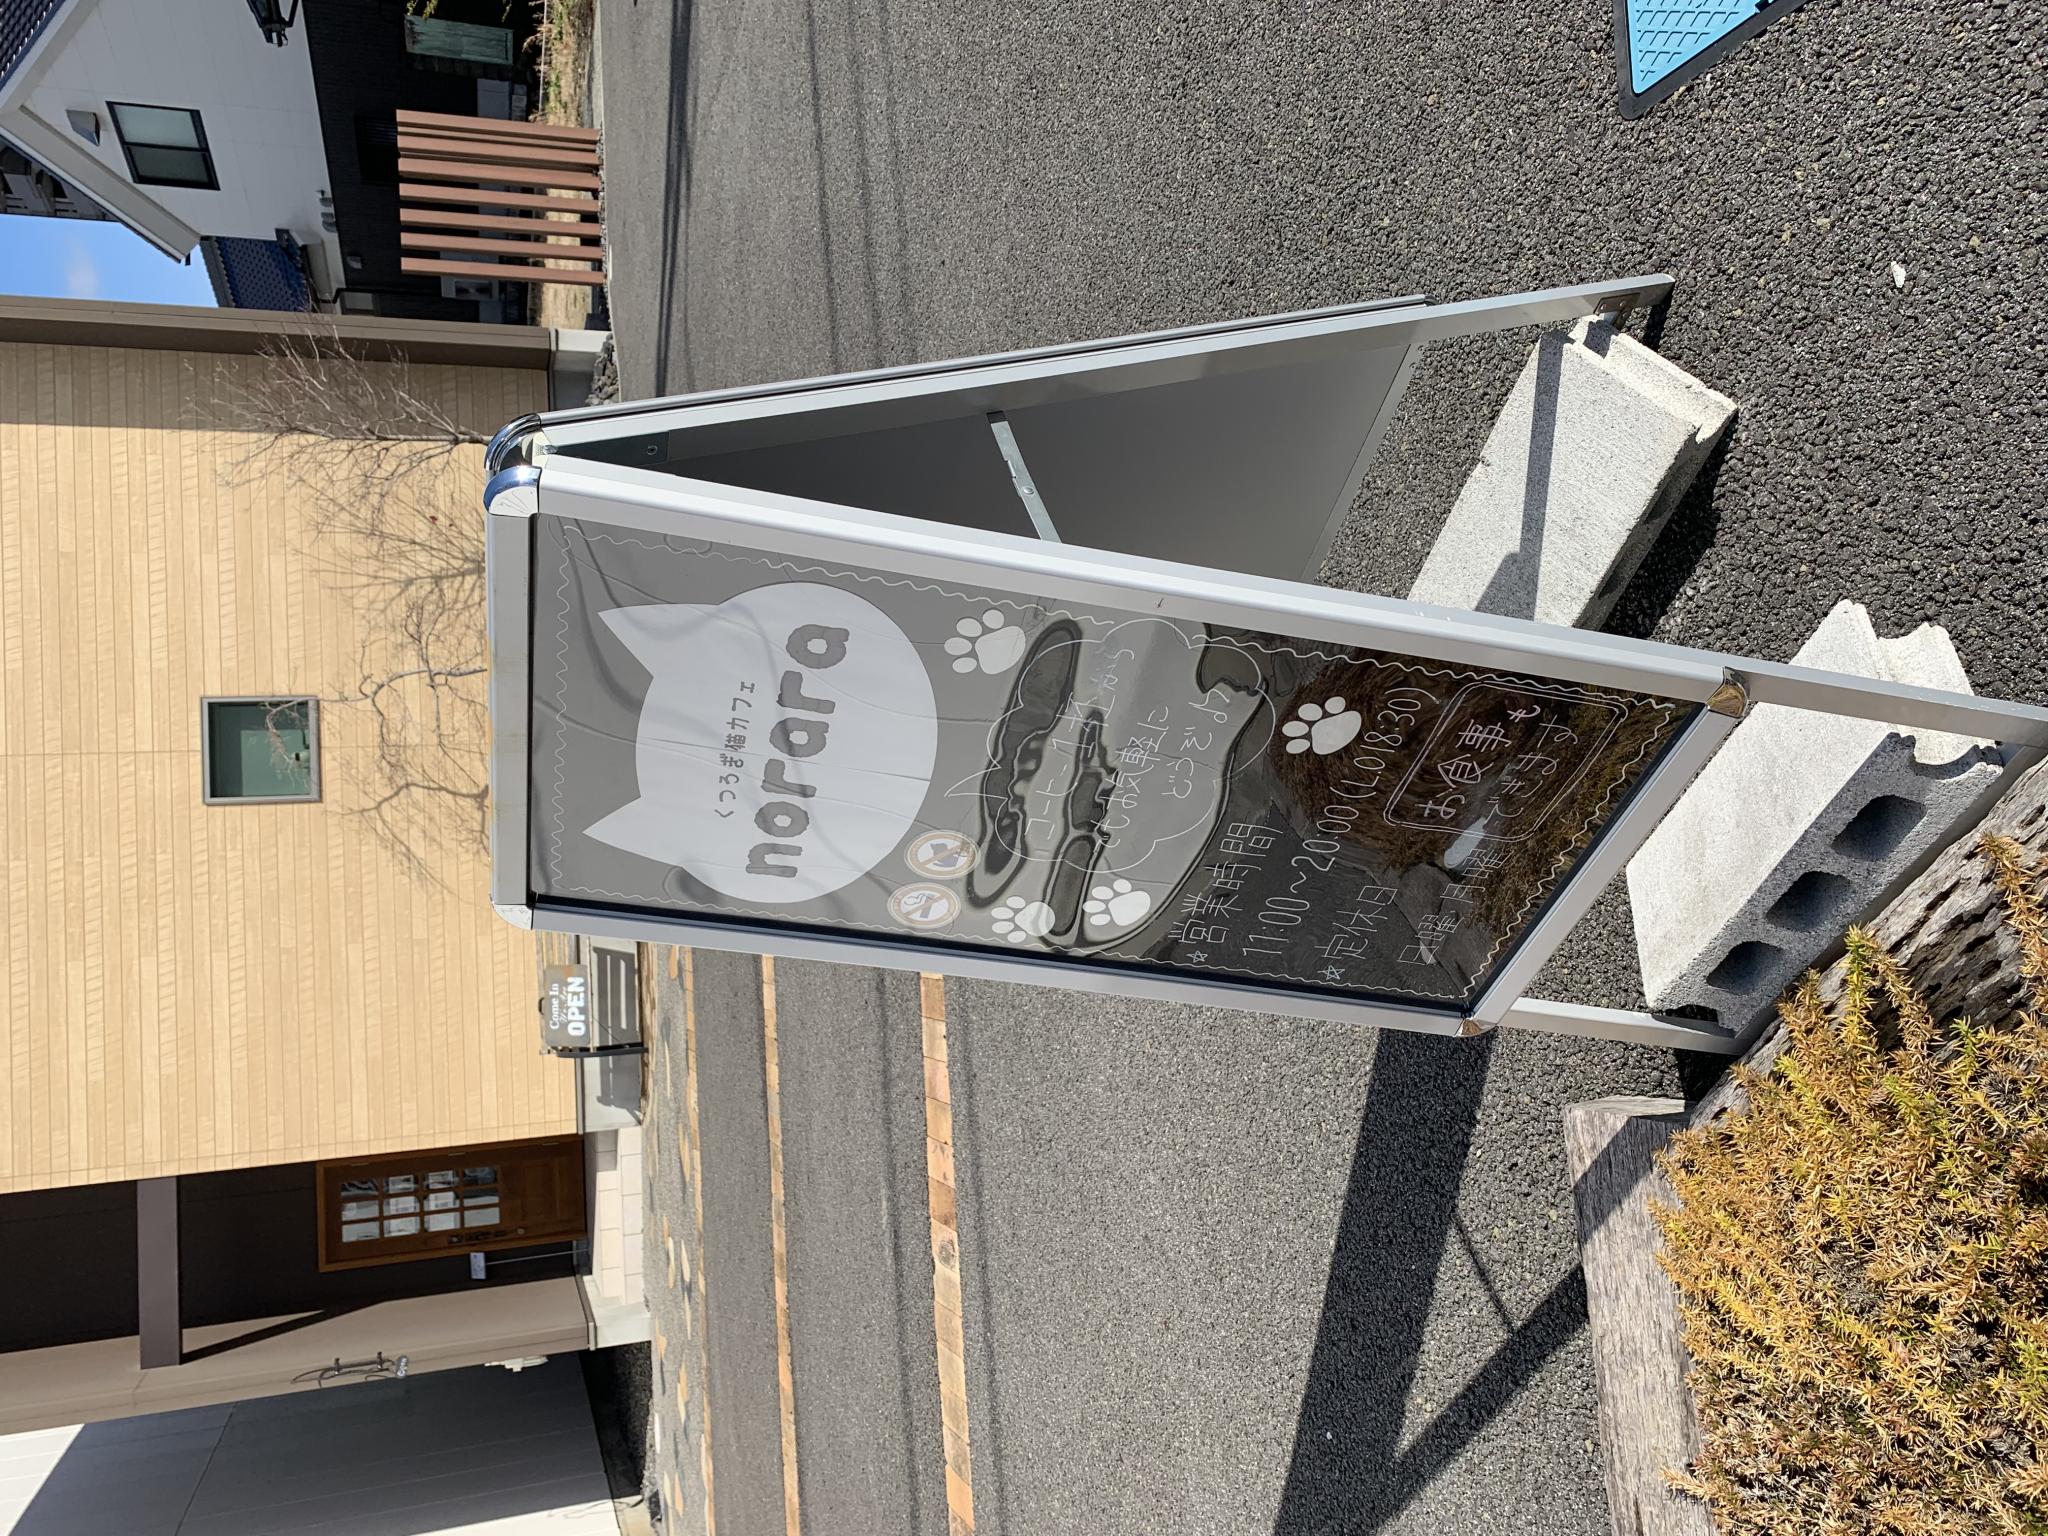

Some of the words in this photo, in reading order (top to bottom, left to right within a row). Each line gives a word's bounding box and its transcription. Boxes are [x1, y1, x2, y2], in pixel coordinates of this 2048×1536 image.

[714, 680, 755, 819] くつろぎ猫カフェ
[745, 624, 849, 878] norara
[1414, 704, 1541, 819] お食事も
[1474, 714, 1578, 825] できます
[1168, 823, 1283, 944] 営業時間
[1314, 886, 1398, 959] 定休日
[548, 983, 559, 996] In
[549, 998, 560, 1030] Come
[566, 976, 586, 1036] OPEN
